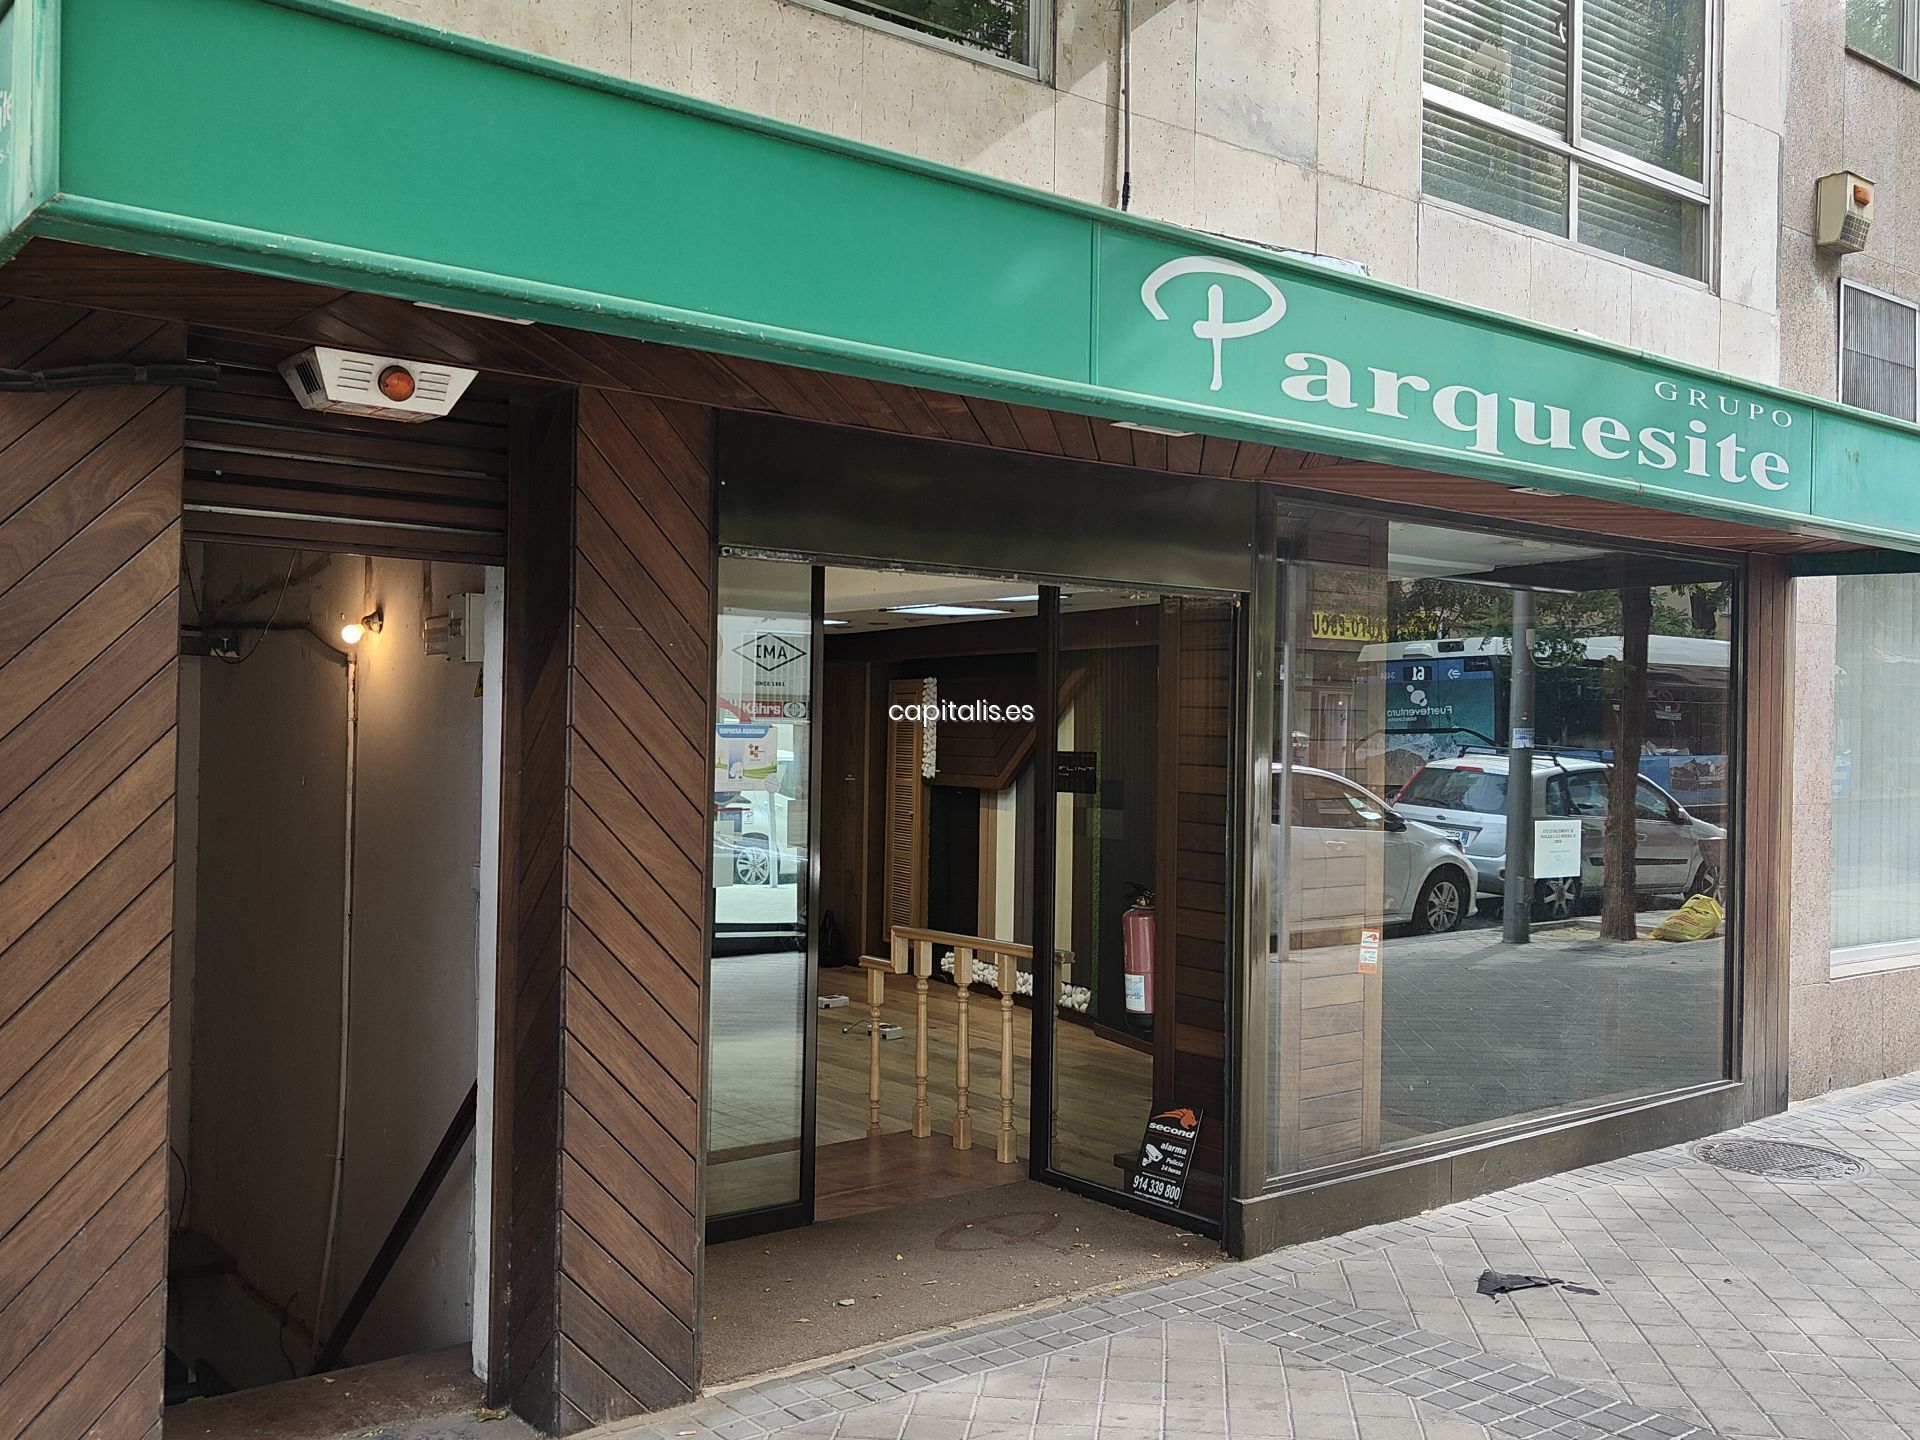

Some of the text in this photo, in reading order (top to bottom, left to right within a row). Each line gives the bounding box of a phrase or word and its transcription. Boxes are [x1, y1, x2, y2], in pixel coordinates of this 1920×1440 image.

[1141, 255, 1791, 492] Parquesite
[1654, 380, 1794, 428] GRUPO
[755, 644, 788, 660] IMA
[1148, 1122, 1196, 1139] second
[1160, 1142, 1188, 1155] alarma
[1132, 1174, 1149, 1191] 914
[1148, 1179, 1165, 1196] 339
[1164, 1184, 1181, 1201] 800
